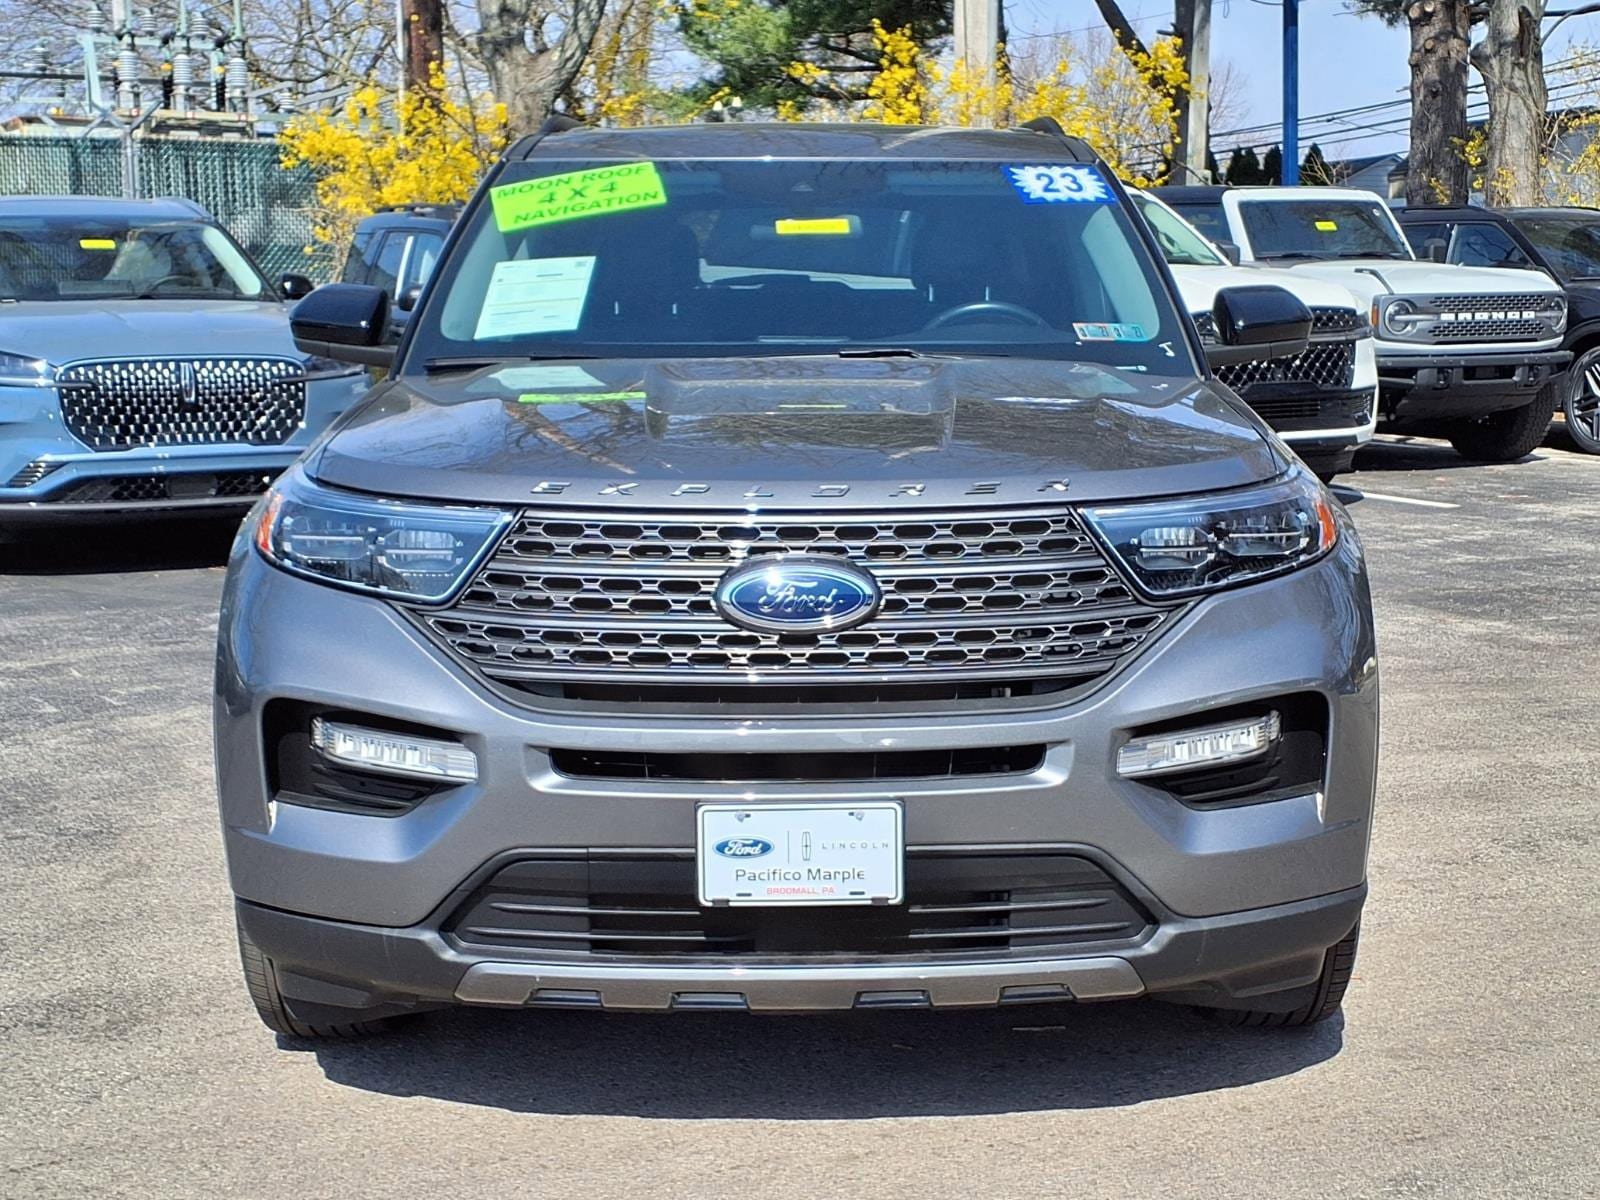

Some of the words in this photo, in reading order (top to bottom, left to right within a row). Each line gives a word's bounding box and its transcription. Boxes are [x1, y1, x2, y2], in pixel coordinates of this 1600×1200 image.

[497, 176, 571, 198] MOON
[582, 165, 650, 183] ROOF
[1036, 172, 1084, 193] 23
[513, 191, 659, 224] NAVIGATION
[1440, 311, 1536, 320] BRONCO
[530, 478, 1071, 497] EXPLORER
[758, 578, 843, 613] Ford
[724, 838, 763, 856] Ford
[822, 842, 889, 850] LINCOLN
[735, 868, 801, 882] Pacifico
[807, 868, 865, 883] Marple
